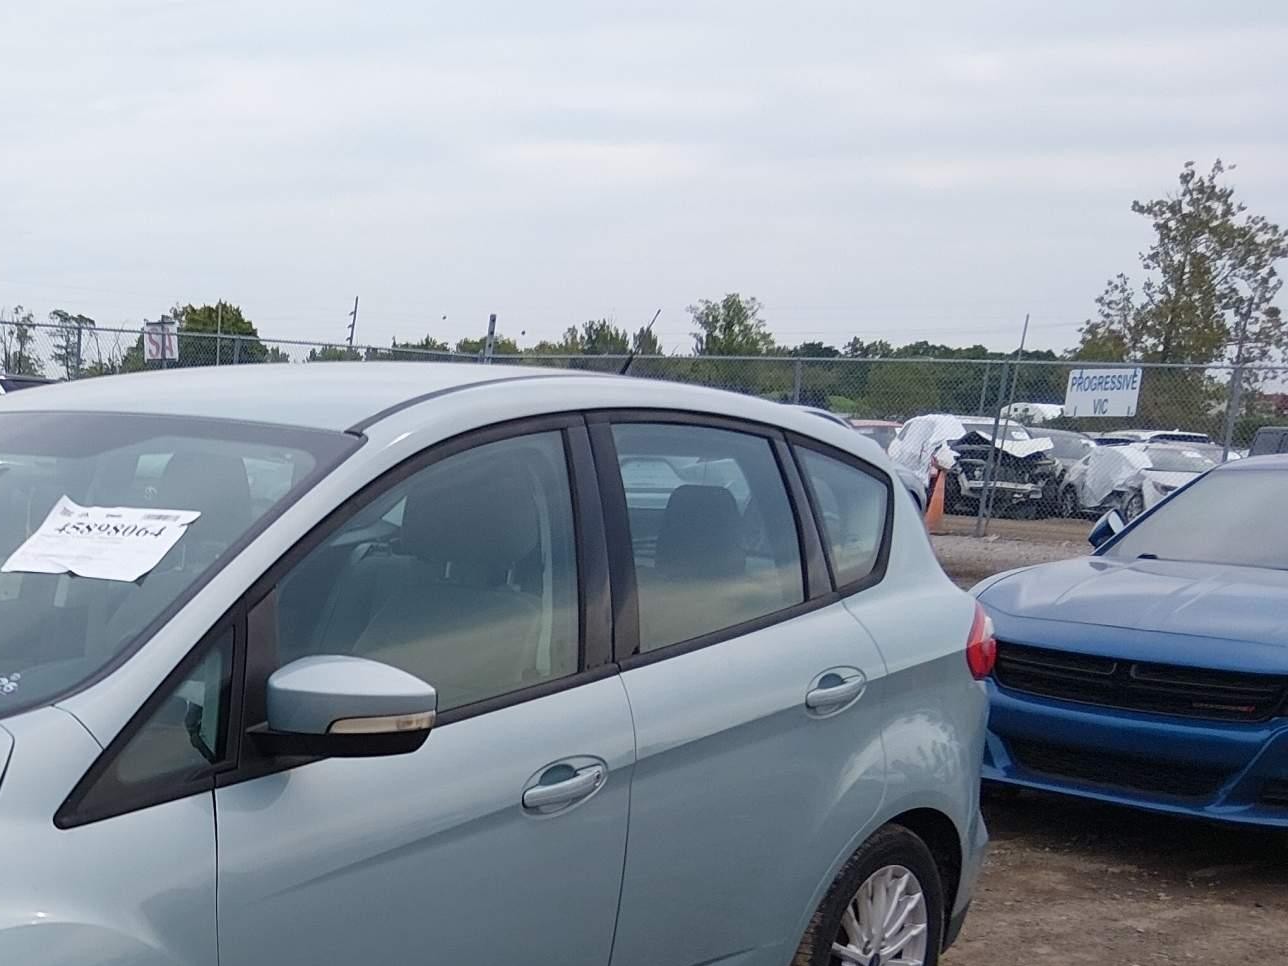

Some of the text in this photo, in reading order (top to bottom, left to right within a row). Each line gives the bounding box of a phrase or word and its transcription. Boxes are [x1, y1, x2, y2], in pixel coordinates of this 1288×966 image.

[1070, 374, 1138, 393] PROGRESSIVE
[1093, 398, 1109, 415] VIC
[54, 521, 167, 539] 45898064
